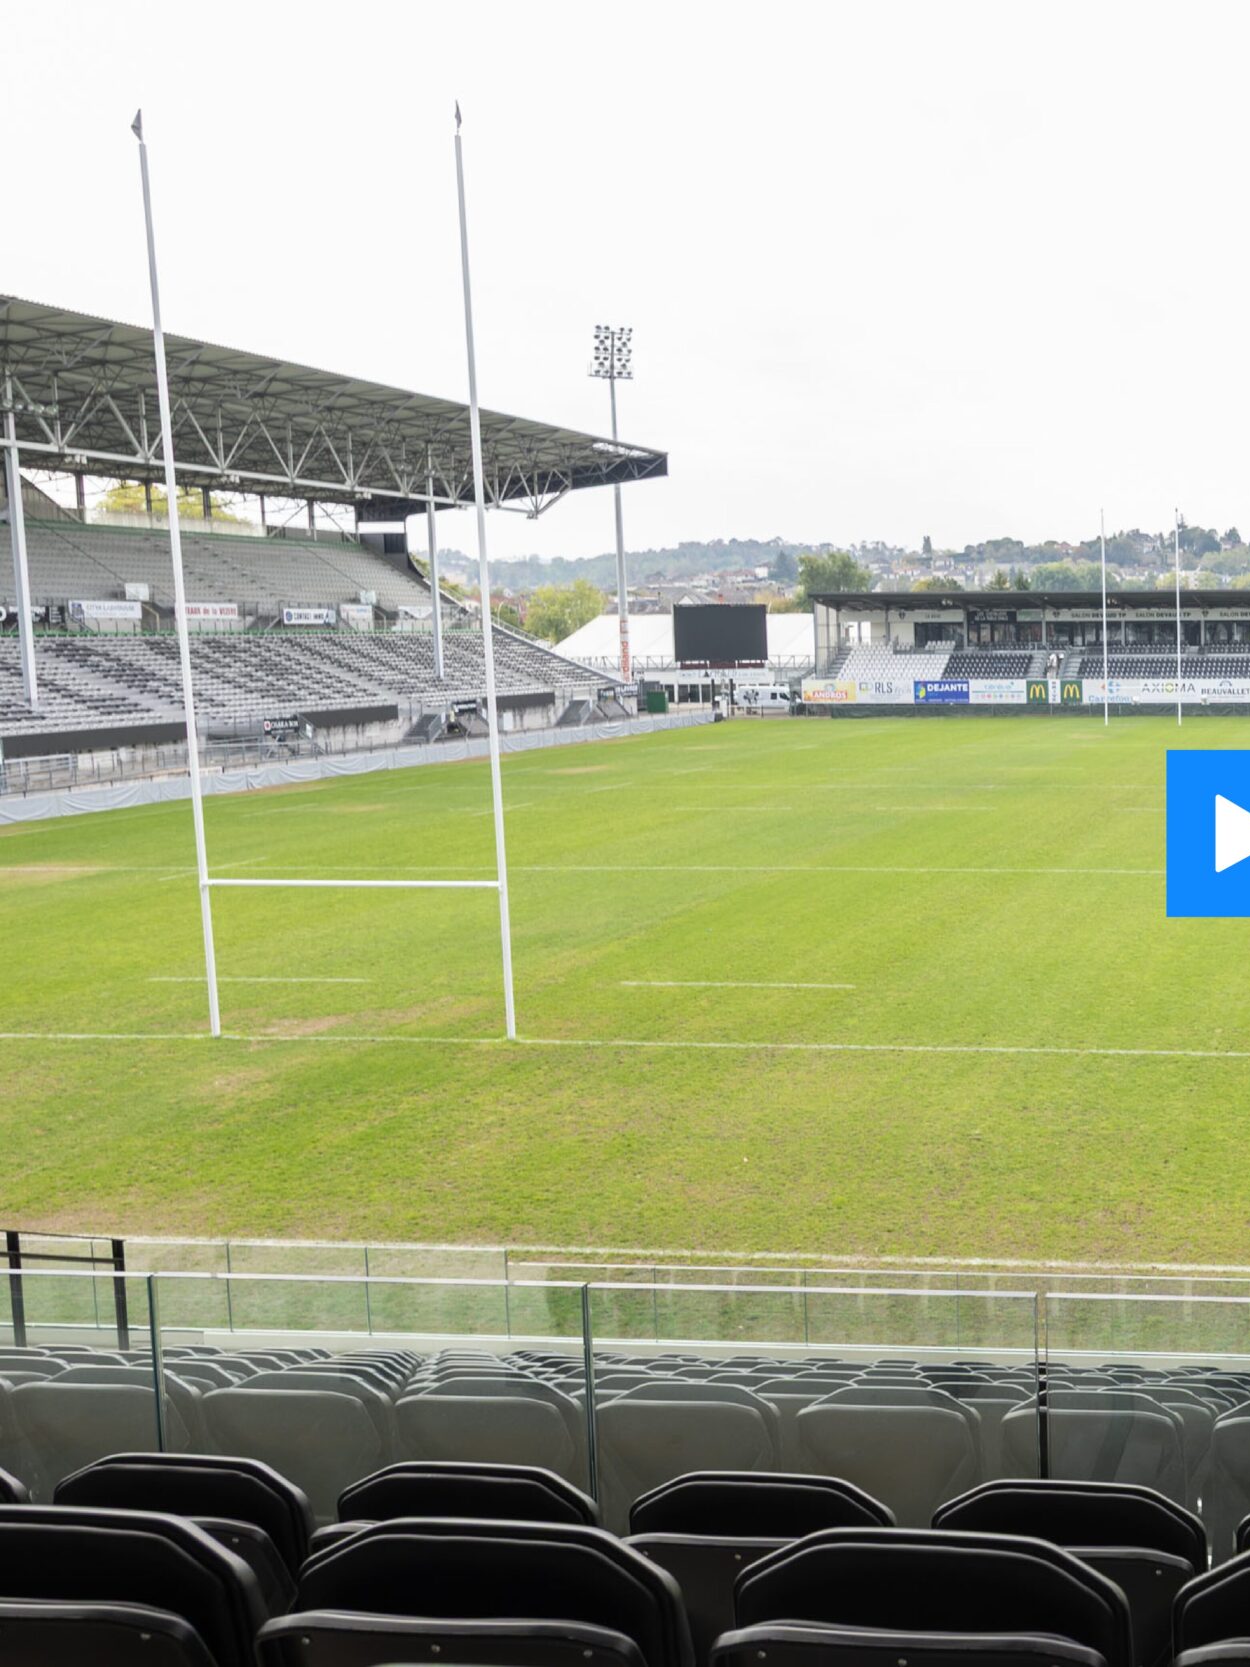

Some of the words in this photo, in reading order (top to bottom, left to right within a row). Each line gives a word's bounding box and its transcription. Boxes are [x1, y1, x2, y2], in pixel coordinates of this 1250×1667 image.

[875, 682, 893, 694] RLS
[927, 683, 969, 692] DEJANTE
[1142, 683, 1196, 693] AXIOMA
[1201, 687, 1250, 696] BEAUVALLET
